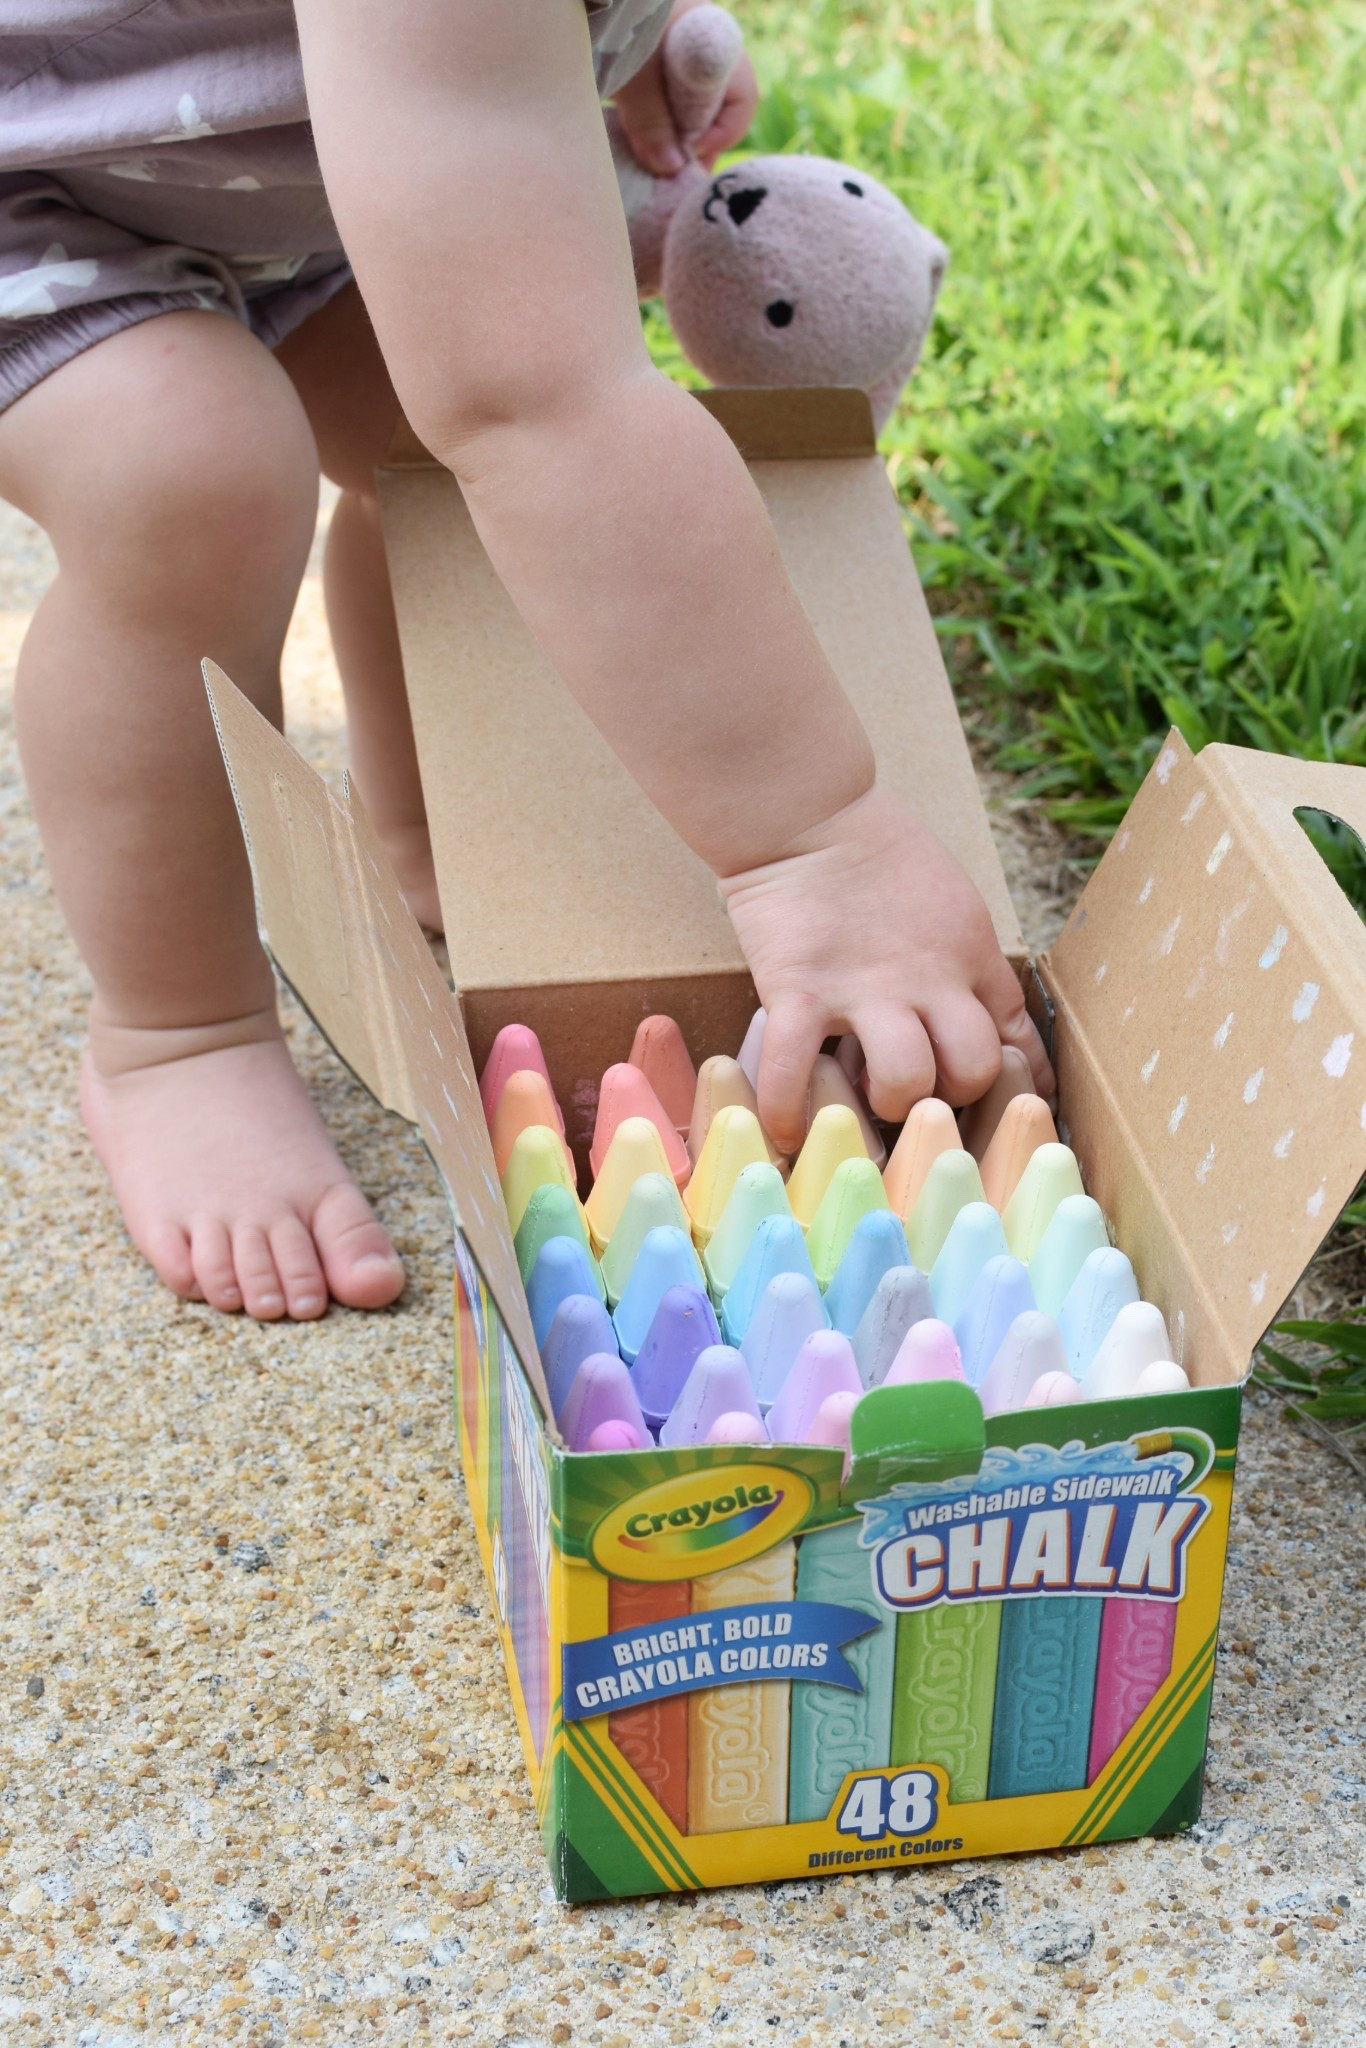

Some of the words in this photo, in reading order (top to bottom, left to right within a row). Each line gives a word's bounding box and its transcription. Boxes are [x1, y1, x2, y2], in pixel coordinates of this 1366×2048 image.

[625, 1485, 774, 1537] Crayola
[908, 1483, 1048, 1529] Washable
[1052, 1471, 1174, 1502] Sidewalk
[881, 1502, 1196, 1601] CHALK
[613, 1622, 718, 1666] BRIGHT,
[724, 1613, 792, 1641] BOLD
[576, 1652, 714, 1707] CRAYOLA
[720, 1643, 828, 1673] COLORS
[838, 1772, 937, 1839] 48
[808, 1845, 897, 1868] Different
[900, 1837, 964, 1857] Colors
